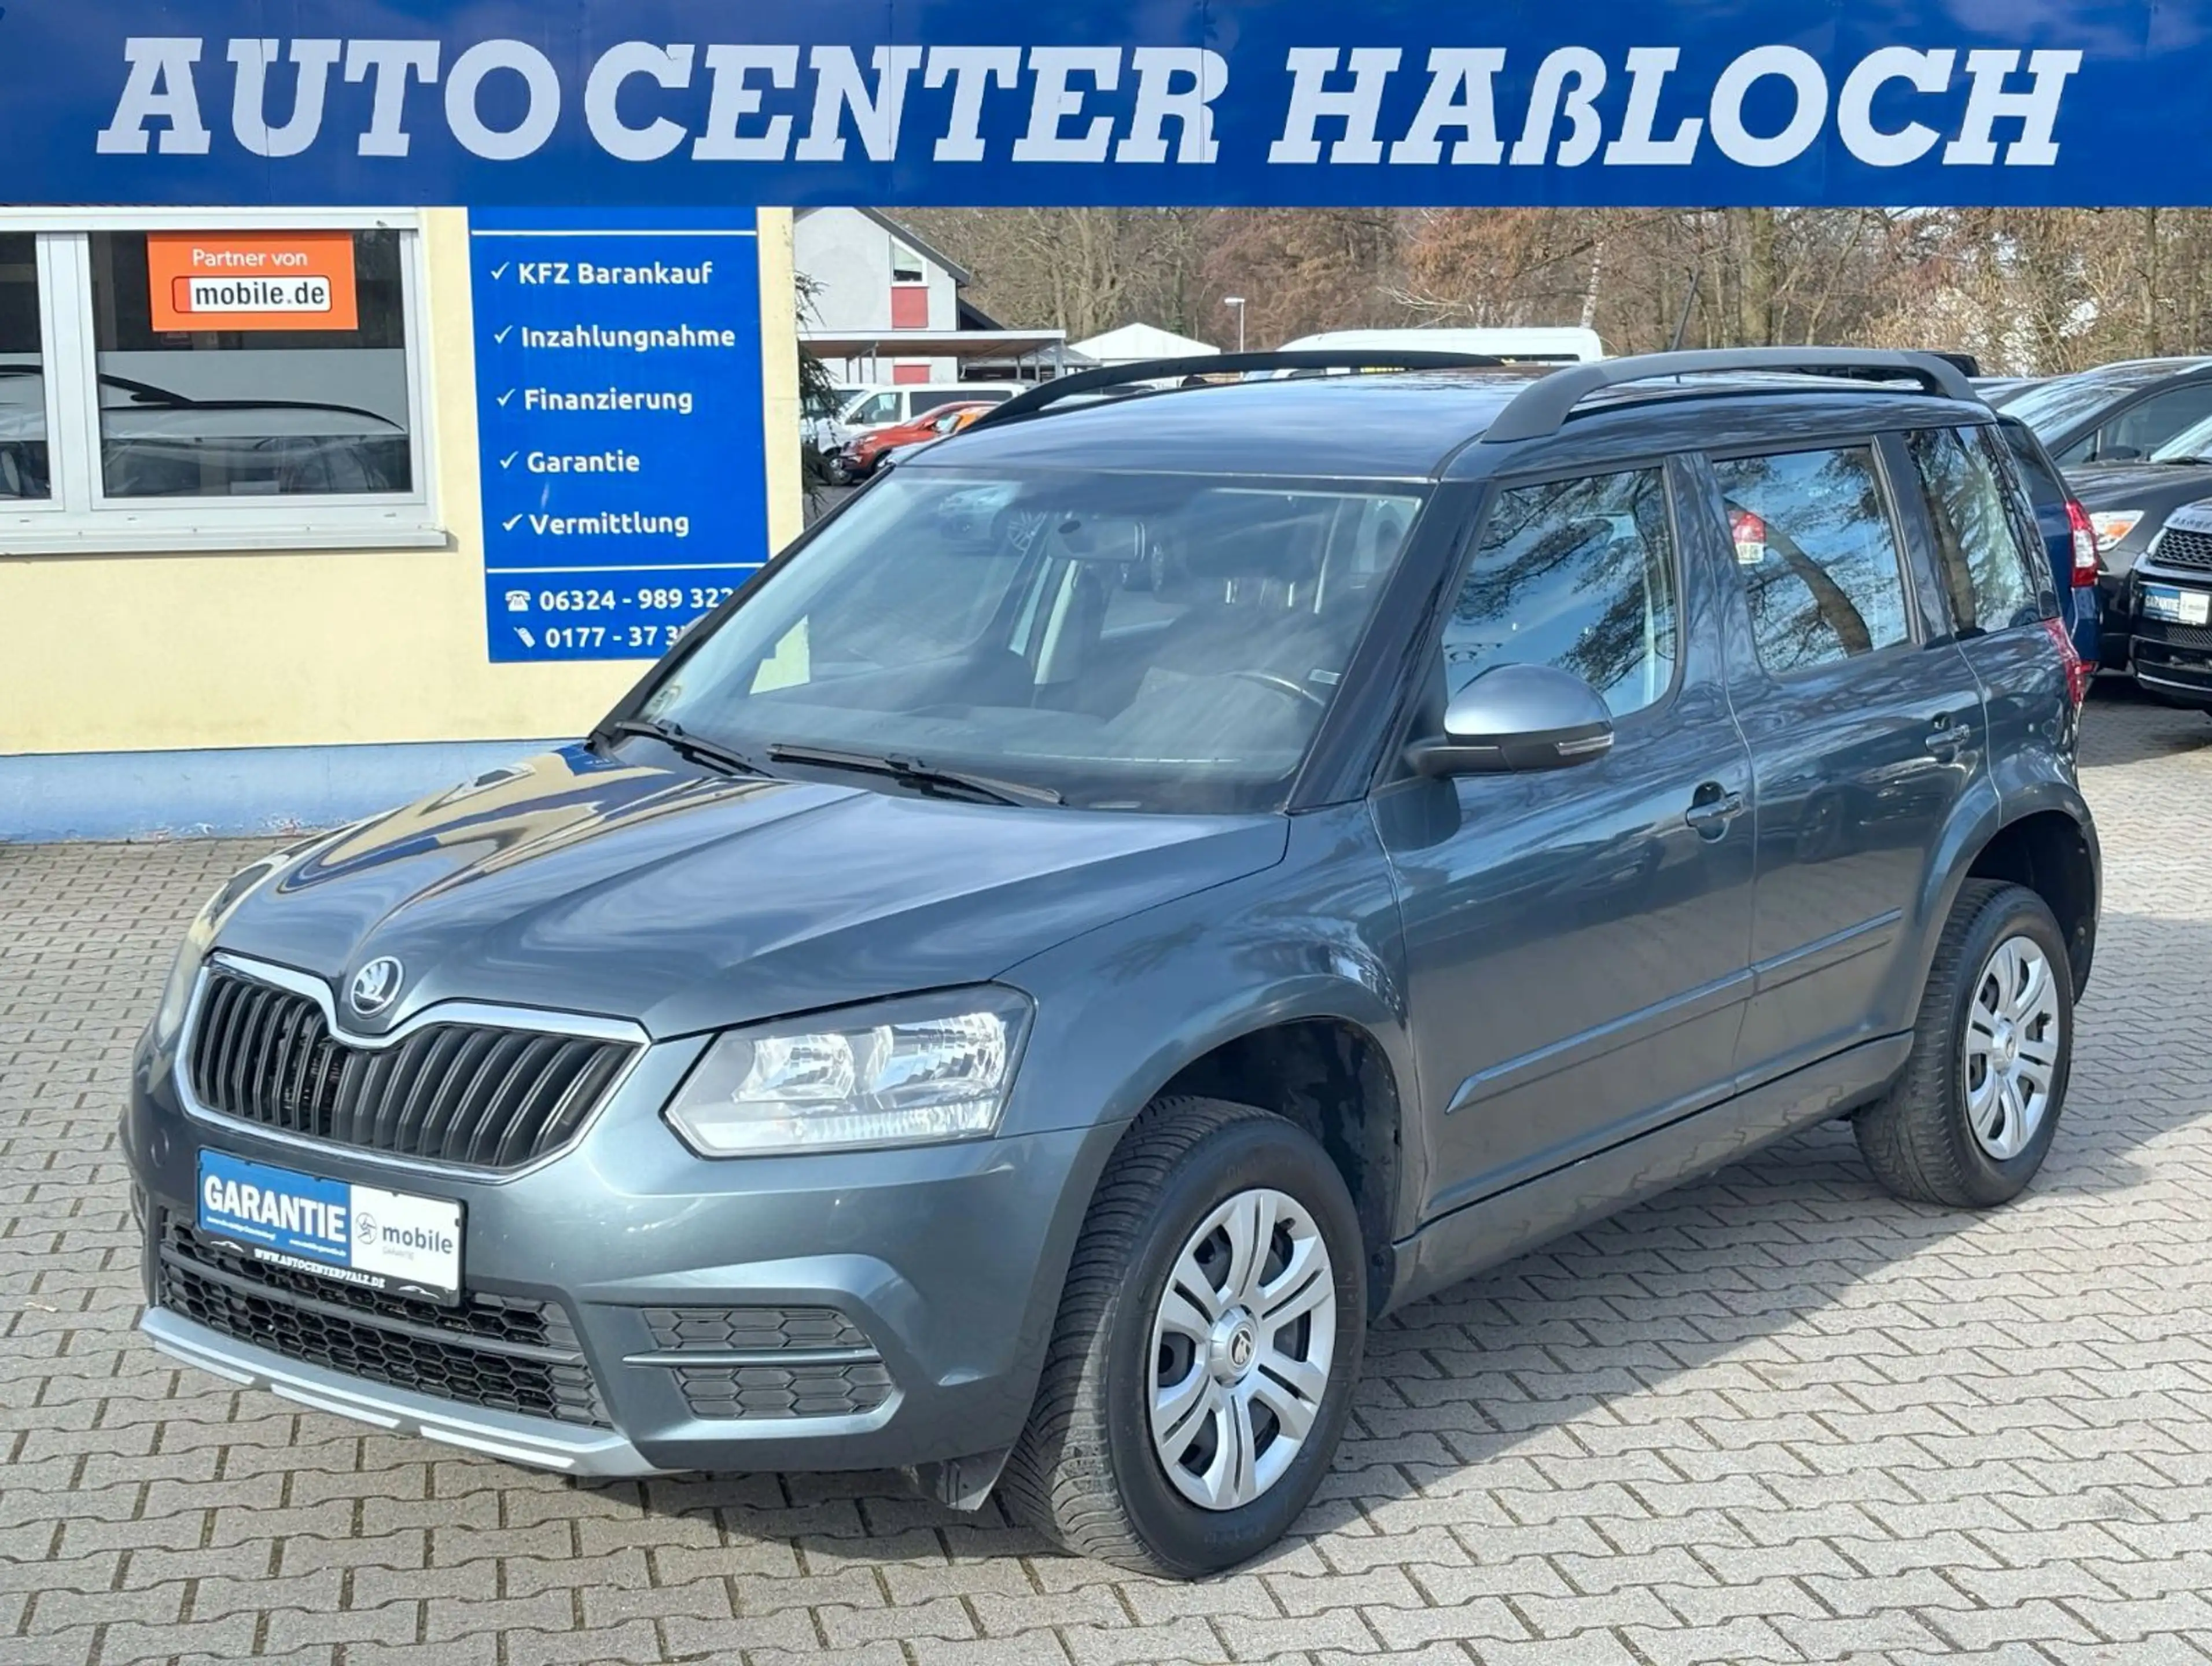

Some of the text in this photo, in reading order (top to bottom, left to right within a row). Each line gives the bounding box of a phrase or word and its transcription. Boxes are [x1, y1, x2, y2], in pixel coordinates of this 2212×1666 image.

[1268, 45, 2083, 167] HAßLOCH
[193, 249, 308, 267] Partner von
[519, 261, 713, 284] KFZ Barankauf
[196, 281, 324, 305] mobile.de
[522, 324, 735, 352] Inzahlungnahme
[525, 387, 693, 414] Finanzierung
[527, 449, 641, 473] Garantie
[529, 511, 690, 537] Vermittlung
[539, 589, 616, 611] 06324
[638, 588, 683, 609] 989
[545, 627, 606, 648] 0177
[628, 626, 658, 647] 37
[204, 1174, 347, 1243] GARANTIE
[382, 1225, 454, 1255] mobile
